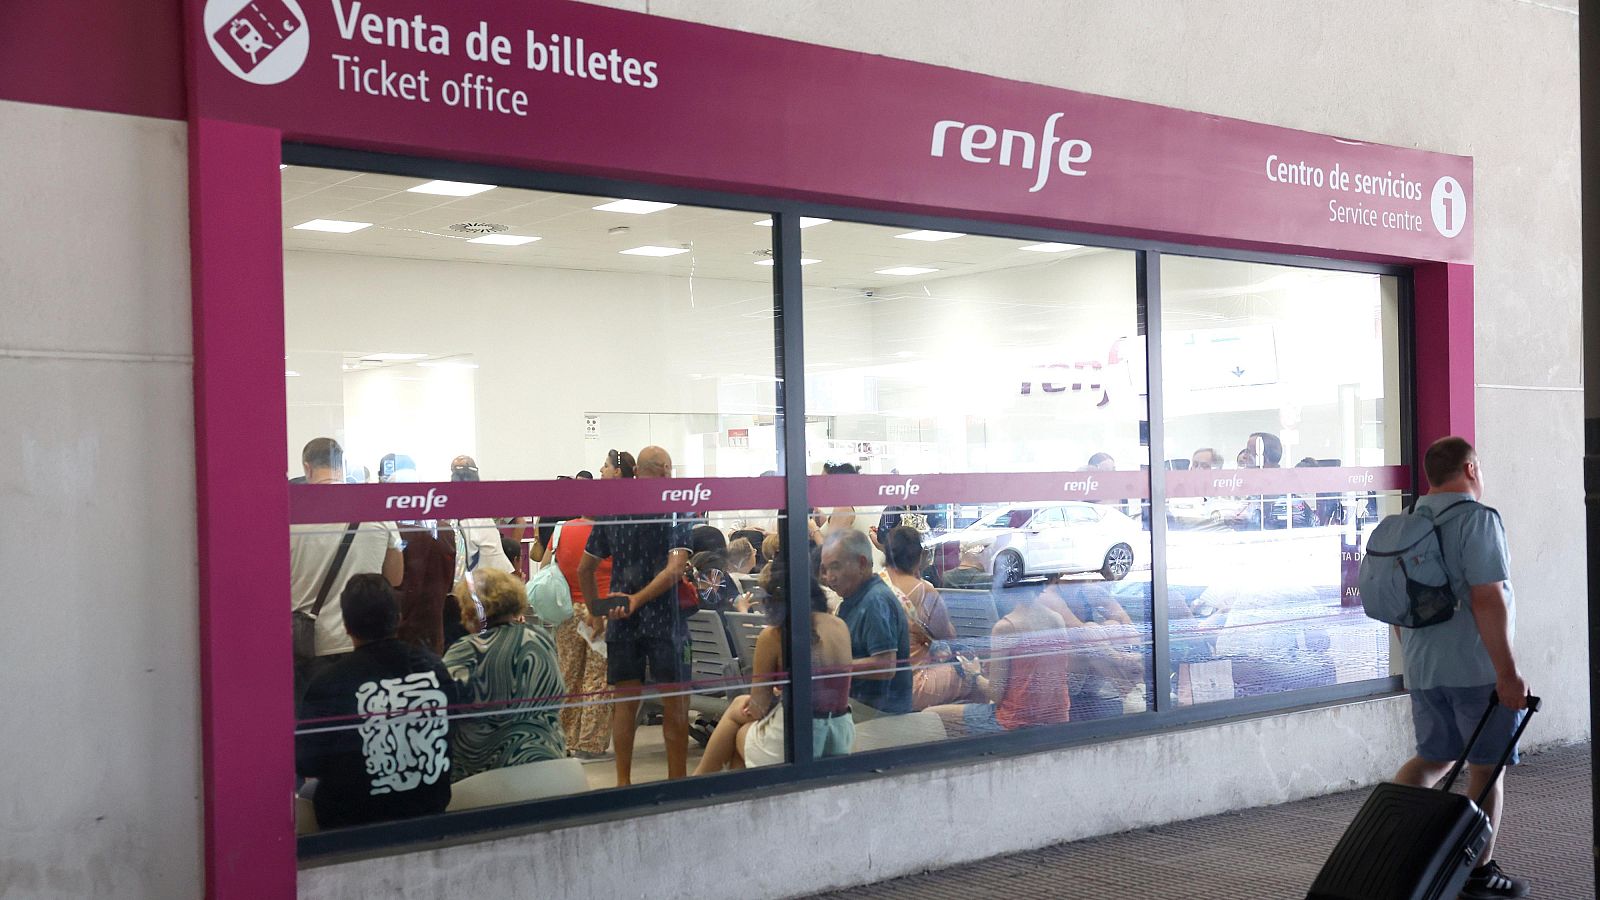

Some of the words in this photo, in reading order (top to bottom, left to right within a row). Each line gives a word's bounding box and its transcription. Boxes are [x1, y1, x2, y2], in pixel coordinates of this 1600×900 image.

[331, 0, 450, 56] Venta
[466, 22, 512, 66] de
[527, 29, 659, 89] billetes
[331, 54, 430, 103] Ticket
[442, 72, 528, 116] office
[930, 112, 1093, 193] renfe
[1265, 154, 1324, 189] Centro
[1329, 162, 1350, 192] de
[1354, 169, 1423, 201] servicios
[1328, 199, 1377, 227] Service
[1382, 206, 1423, 232] centre
[878, 478, 921, 501] renfe
[1063, 476, 1099, 496] renfe
[1213, 473, 1244, 492] renfe
[1348, 470, 1375, 487] renfe
[386, 487, 448, 514] renfe
[661, 482, 712, 507] renfe
